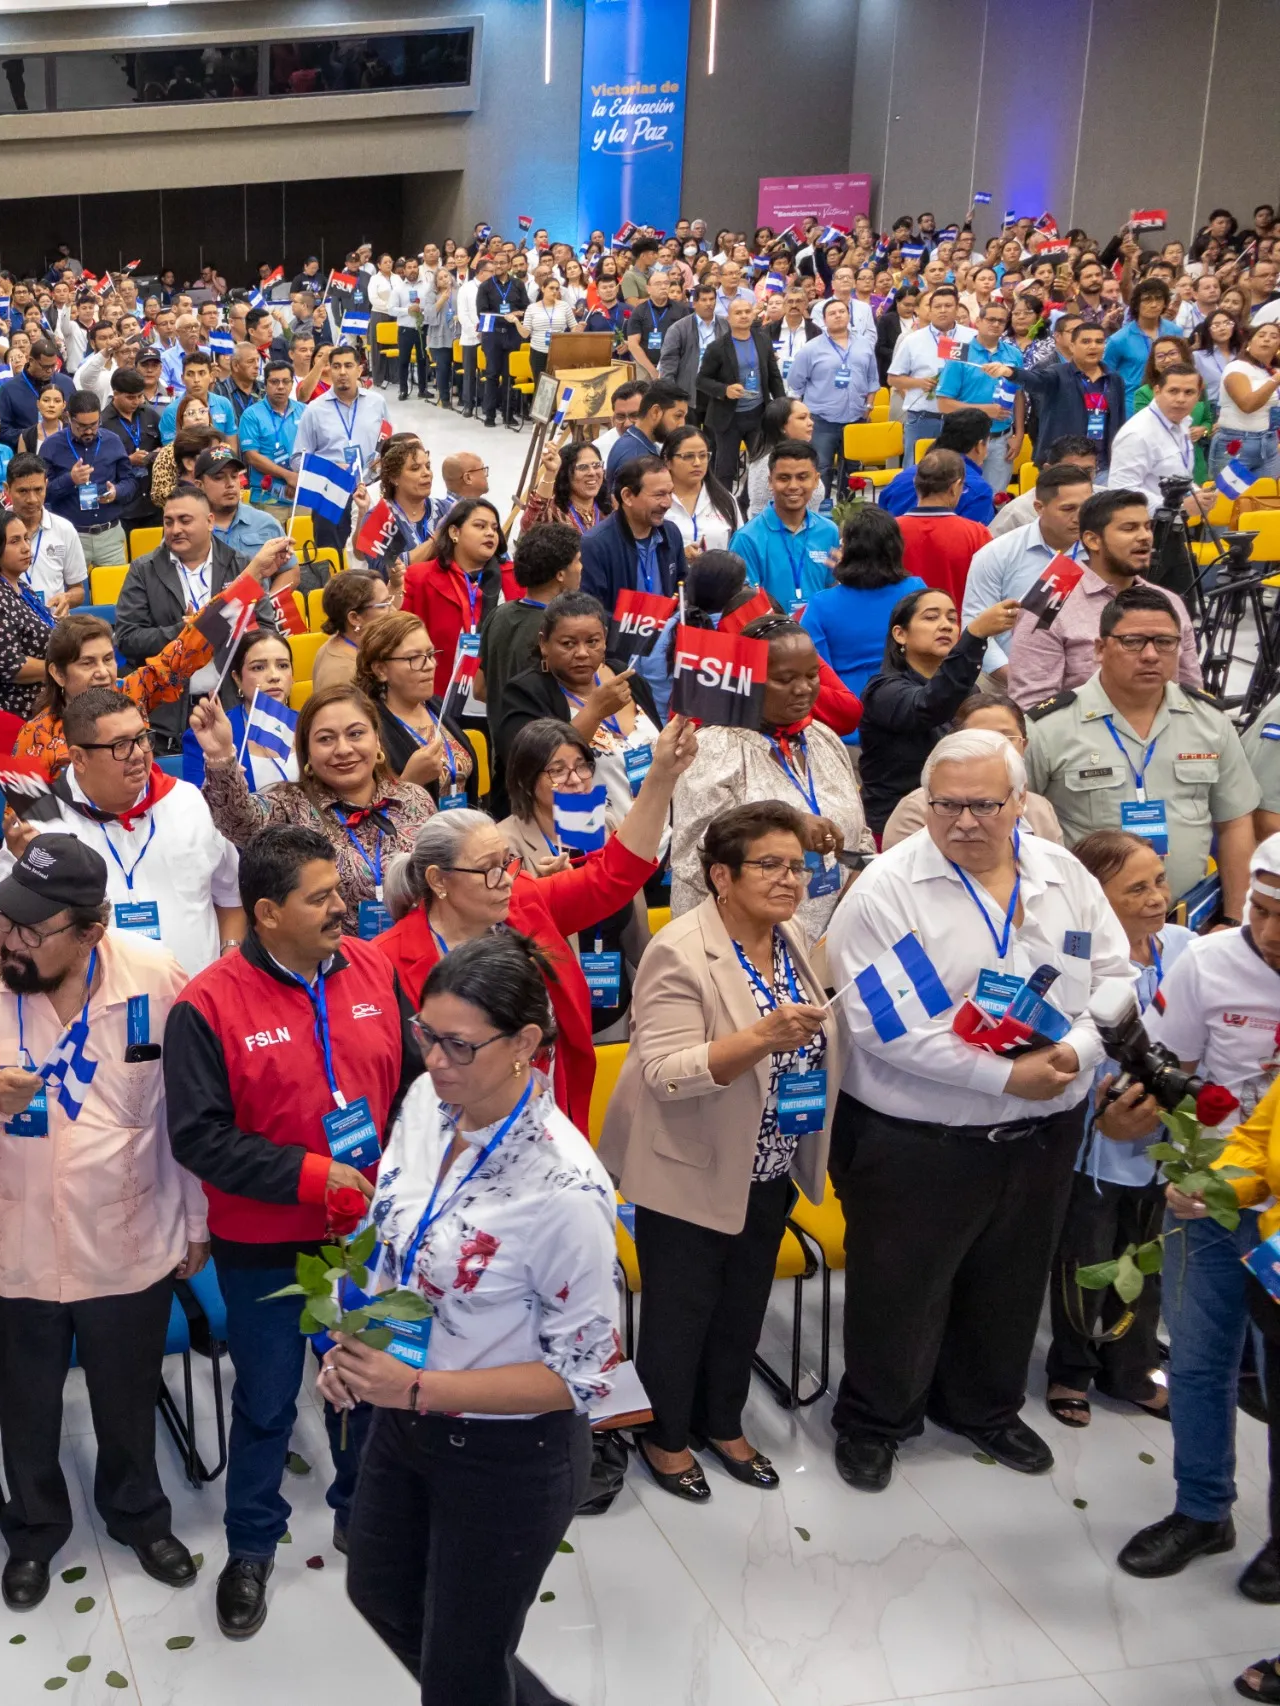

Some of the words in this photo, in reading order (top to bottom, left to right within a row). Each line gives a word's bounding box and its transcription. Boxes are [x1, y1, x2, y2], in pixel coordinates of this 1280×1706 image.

[591, 82, 657, 97] Victorias
[660, 81, 680, 93] de
[591, 99, 607, 118] la
[609, 97, 675, 118] Educación
[591, 128, 607, 152] y
[608, 119, 629, 144] la
[631, 116, 668, 145] Paz
[331, 279, 354, 293] FSLN
[270, 597, 294, 639] FSLN
[673, 651, 752, 697] FSLN
[587, 977, 616, 985] RTICIPANTE
[978, 1000, 1008, 1013] PARTICIP
[244, 1026, 291, 1051] FSLN
[781, 1097, 824, 1110] PARTICIPANTE
[332, 1125, 374, 1153] PARTICIPANTE
[387, 1343, 424, 1363] CIPANTE
